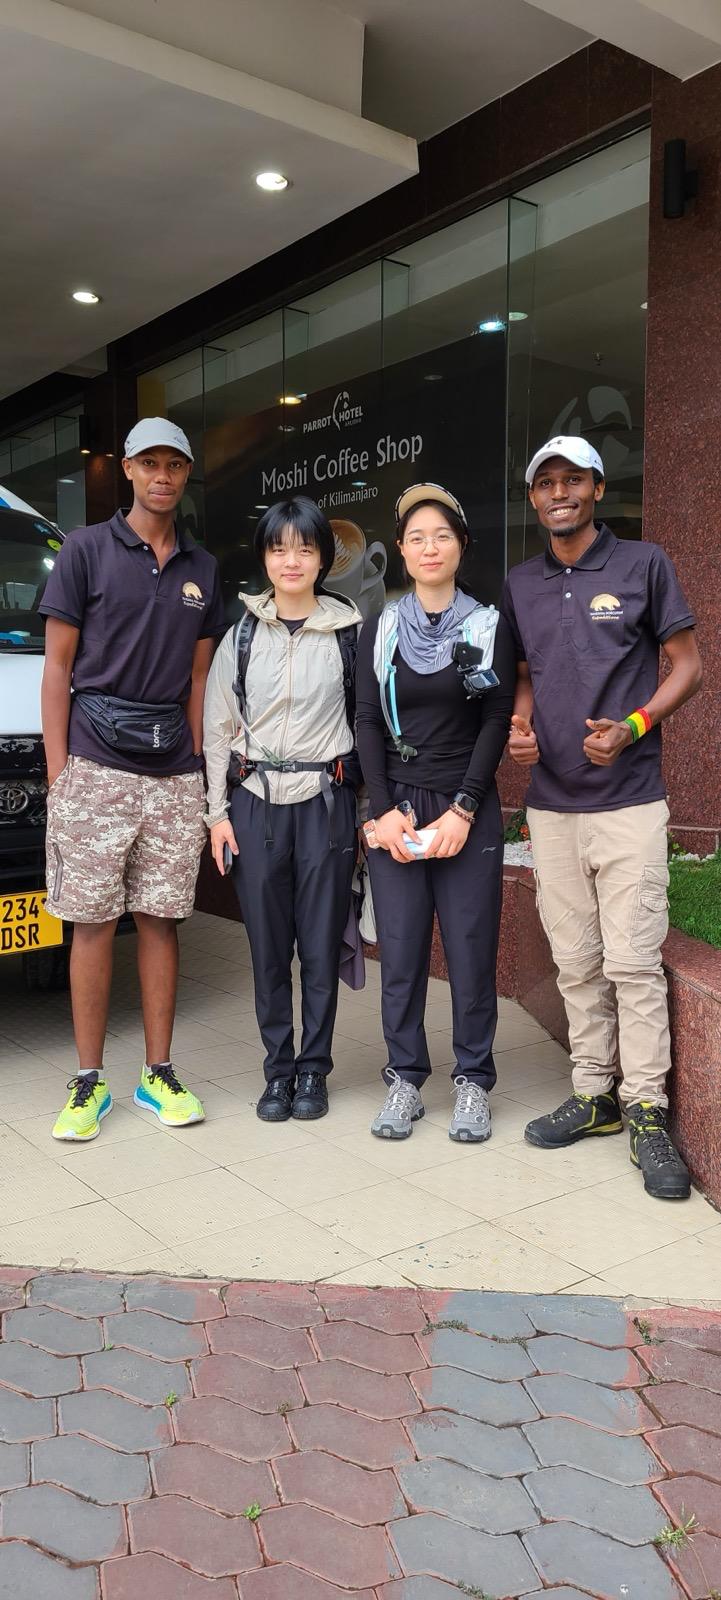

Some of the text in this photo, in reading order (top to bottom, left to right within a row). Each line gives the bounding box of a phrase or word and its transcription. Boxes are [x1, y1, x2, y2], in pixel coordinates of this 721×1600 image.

[303, 415, 331, 433] PARROT
[339, 406, 364, 422] HOTEL
[261, 434, 423, 496] Moshi Coffee Shop
[317, 486, 378, 509] of Kilimanjaro
[152, 724, 161, 748] torch
[2, 896, 39, 923] 234
[1, 923, 40, 950] DSR
